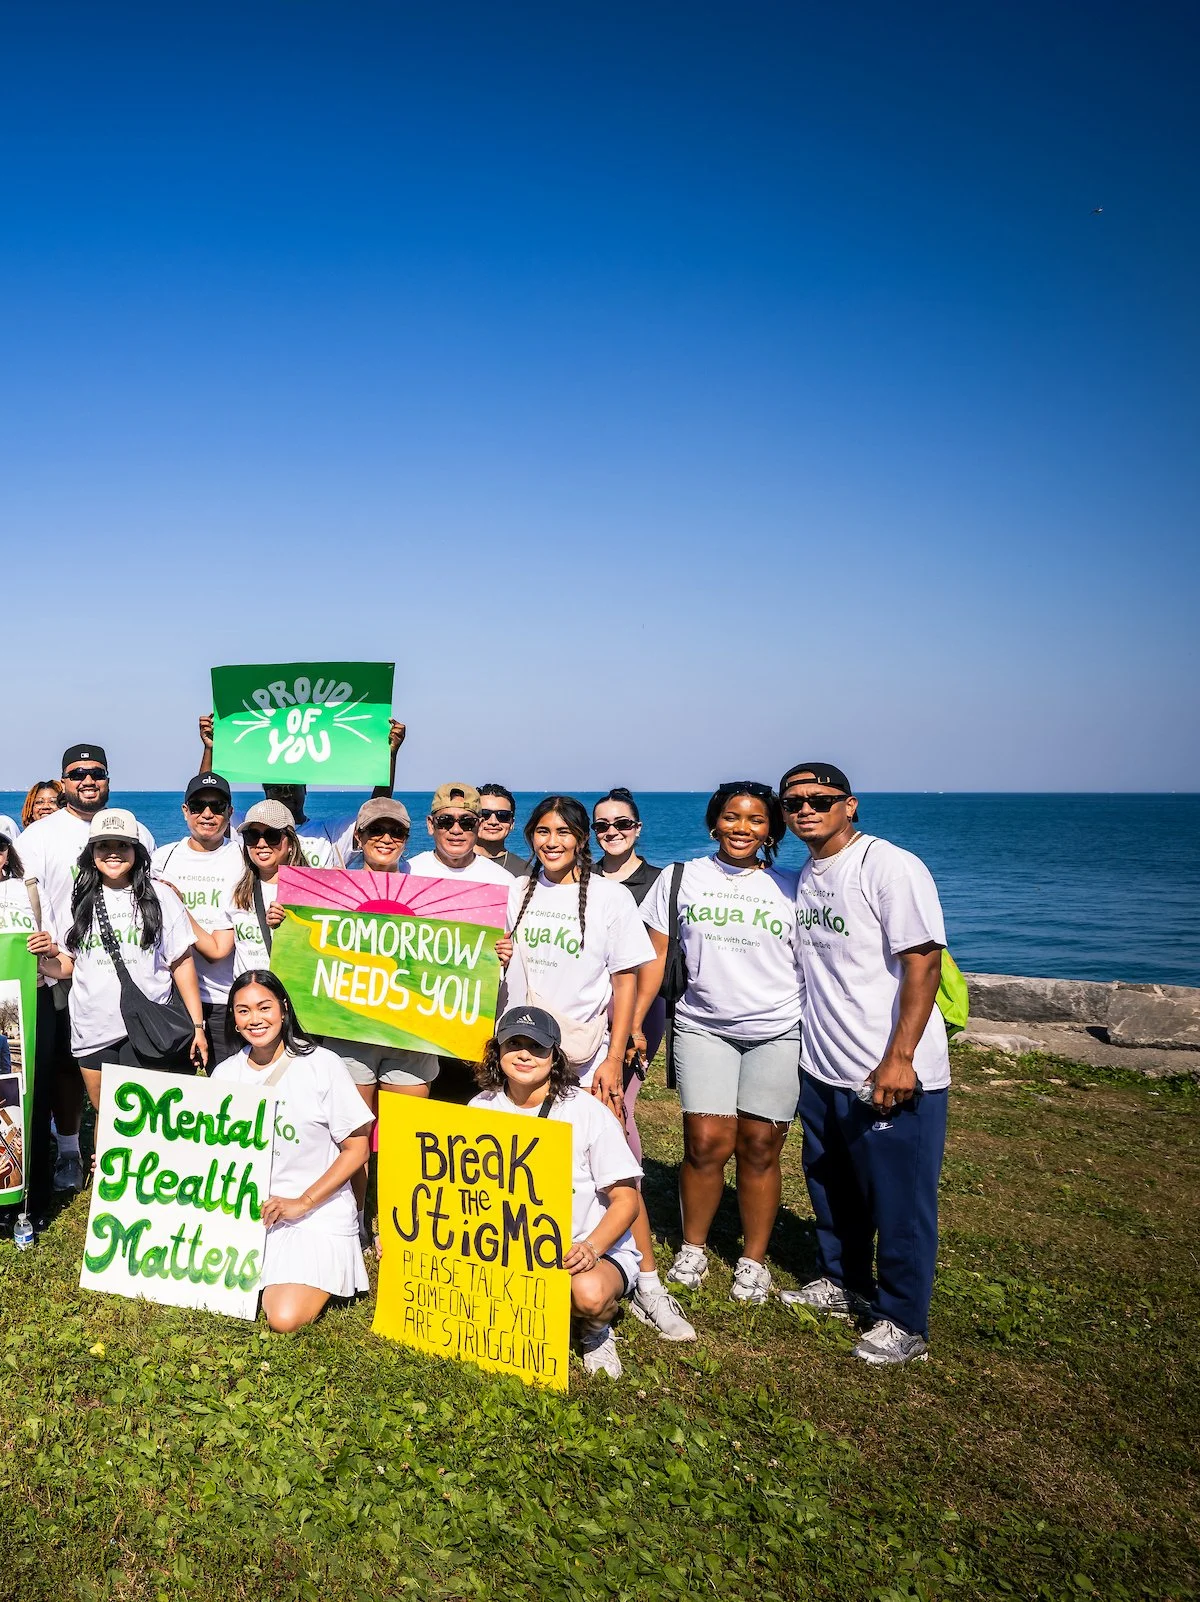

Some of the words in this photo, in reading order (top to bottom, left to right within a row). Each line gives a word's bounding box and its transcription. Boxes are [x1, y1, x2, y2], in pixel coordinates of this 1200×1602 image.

[252, 677, 353, 717] PROUD
[286, 708, 323, 734] OF
[267, 728, 331, 765] YOU
[202, 776, 217, 785] alo
[181, 890, 207, 910] aya
[535, 910, 567, 920] CHICAGO
[686, 904, 745, 927] Kaya
[717, 892, 760, 903] CHICAGO
[822, 905, 850, 936] Ko.
[312, 914, 486, 970] TOMORROW
[554, 926, 580, 959] Ko.
[704, 933, 722, 942] Walk
[723, 936, 740, 944] with
[741, 938, 761, 948] Carlo
[312, 959, 411, 1011] NEEDS
[416, 971, 482, 1025] YOU
[113, 1081, 269, 1151] Mental
[98, 1147, 264, 1222] Health
[84, 1212, 263, 1293] Matters
[403, 1249, 462, 1288] PLEASE
[466, 1262, 514, 1301] TALK
[520, 1275, 546, 1310] TO
[403, 1281, 482, 1322] SOMEONE
[489, 1298, 502, 1327] IF
[510, 1303, 546, 1341] YOU
[404, 1306, 437, 1344] ARE
[442, 1317, 557, 1377] STRUGGLING
